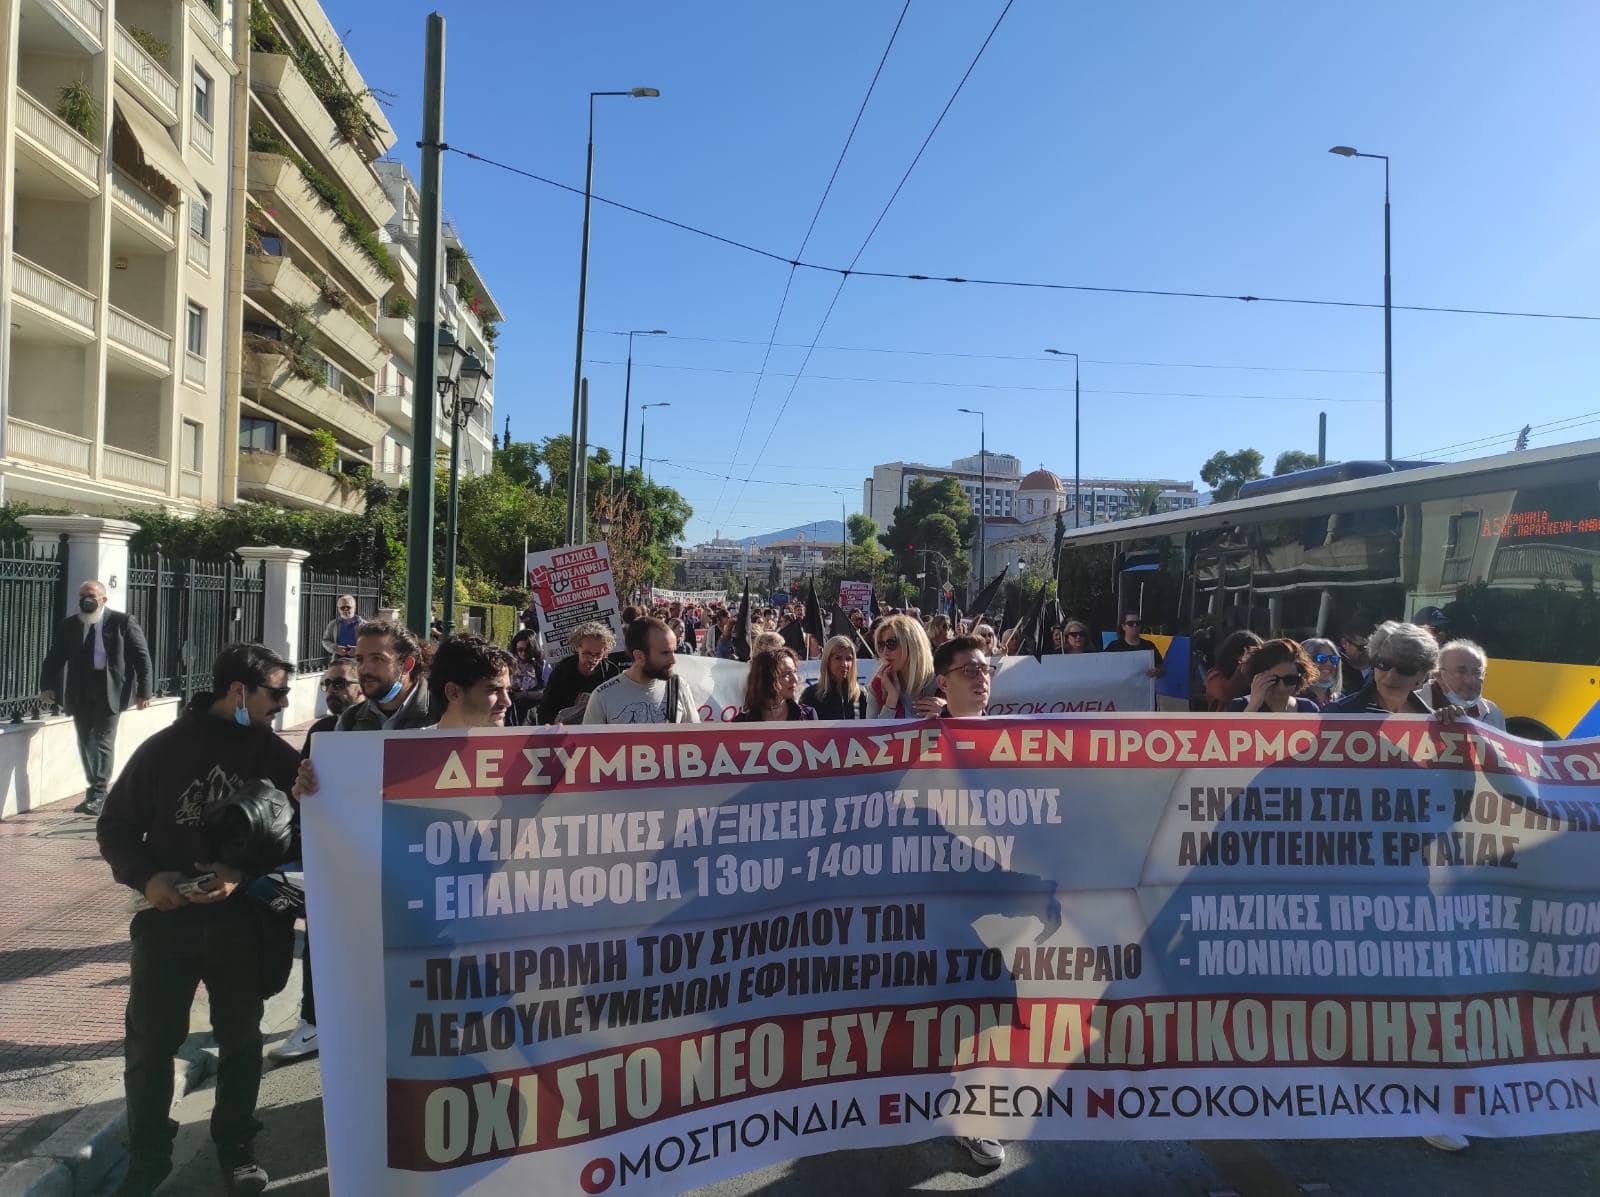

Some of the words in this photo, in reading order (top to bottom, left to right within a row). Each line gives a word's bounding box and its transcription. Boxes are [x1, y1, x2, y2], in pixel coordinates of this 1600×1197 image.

[555, 548, 596, 566] ΜΑΖΙΚΕΣ
[556, 585, 606, 606] ΝΟΣΟΚΟΜΕΙΑ
[985, 700, 1117, 716] ΟΣΟΚΟΜΕΙΑ
[434, 749, 504, 790] ΔΕ
[521, 728, 942, 786] ΣΥΜΒΙΒΑΖΟΜΑΣΤΕ
[989, 729, 1075, 763] ΔΕΝ
[673, 798, 827, 849] ΑΥΞΗΣΕΙΣ
[832, 789, 919, 834] ΣΤΟΥΣ
[927, 787, 1062, 826] ΜΙΣΘΟΥΣ
[1310, 786, 1363, 823] ΣΤΑ
[1178, 830, 1376, 867] ΑΝΘΥΓΙΕΙΝΗΣ
[1381, 830, 1520, 869] ΕΡΓΑΣΙΑΣ
[434, 859, 682, 921] ΕΠΑΝΑΦΟΡΑ
[891, 834, 1016, 874] ΜΙΣΘΟΥ
[1328, 894, 1522, 933] ΠΡΟΣΛΗΨΕΙΣ
[636, 930, 706, 978] ΤΟΥ
[710, 906, 854, 966] ΣΥΝΟΛΟΥ
[862, 903, 926, 944] ΤΩΝ
[1198, 939, 1453, 978] ΜΟΝΙΜΟΠΟΙΗΣΗ
[411, 971, 731, 1057] ΔΕΔΟΥΛΕΥΜΕΝΩΝ
[738, 949, 938, 1004] ΕΦΗΜΕΡΙΩΝ
[945, 947, 1003, 984] ΣΤΟ
[1010, 942, 1143, 983] ΑΚΕΡΑΙΟ
[424, 1073, 539, 1164] ΟΧΙ
[556, 1046, 662, 1140] ΣΤΟ
[679, 1022, 785, 1108] ΝΕΟ
[801, 1011, 894, 1081] ΕΣΥ
[905, 1003, 1013, 1069] ΤΩΝ
[1028, 996, 1525, 1065] ΙΔΙΩΤΙΚΟΠΟΙΗΣΕΩΝ
[579, 1096, 867, 1195] ΟΜΟΣΠΟΝΔΙΑ
[879, 1084, 1073, 1126] ΕΝΩΣΕΩΝ
[1087, 1083, 1440, 1120] ΝΟΣΟΚΟΜΕΙΑΚΩΝ
[1453, 1076, 1600, 1116] ΓΙΑΤΡΩΝ
